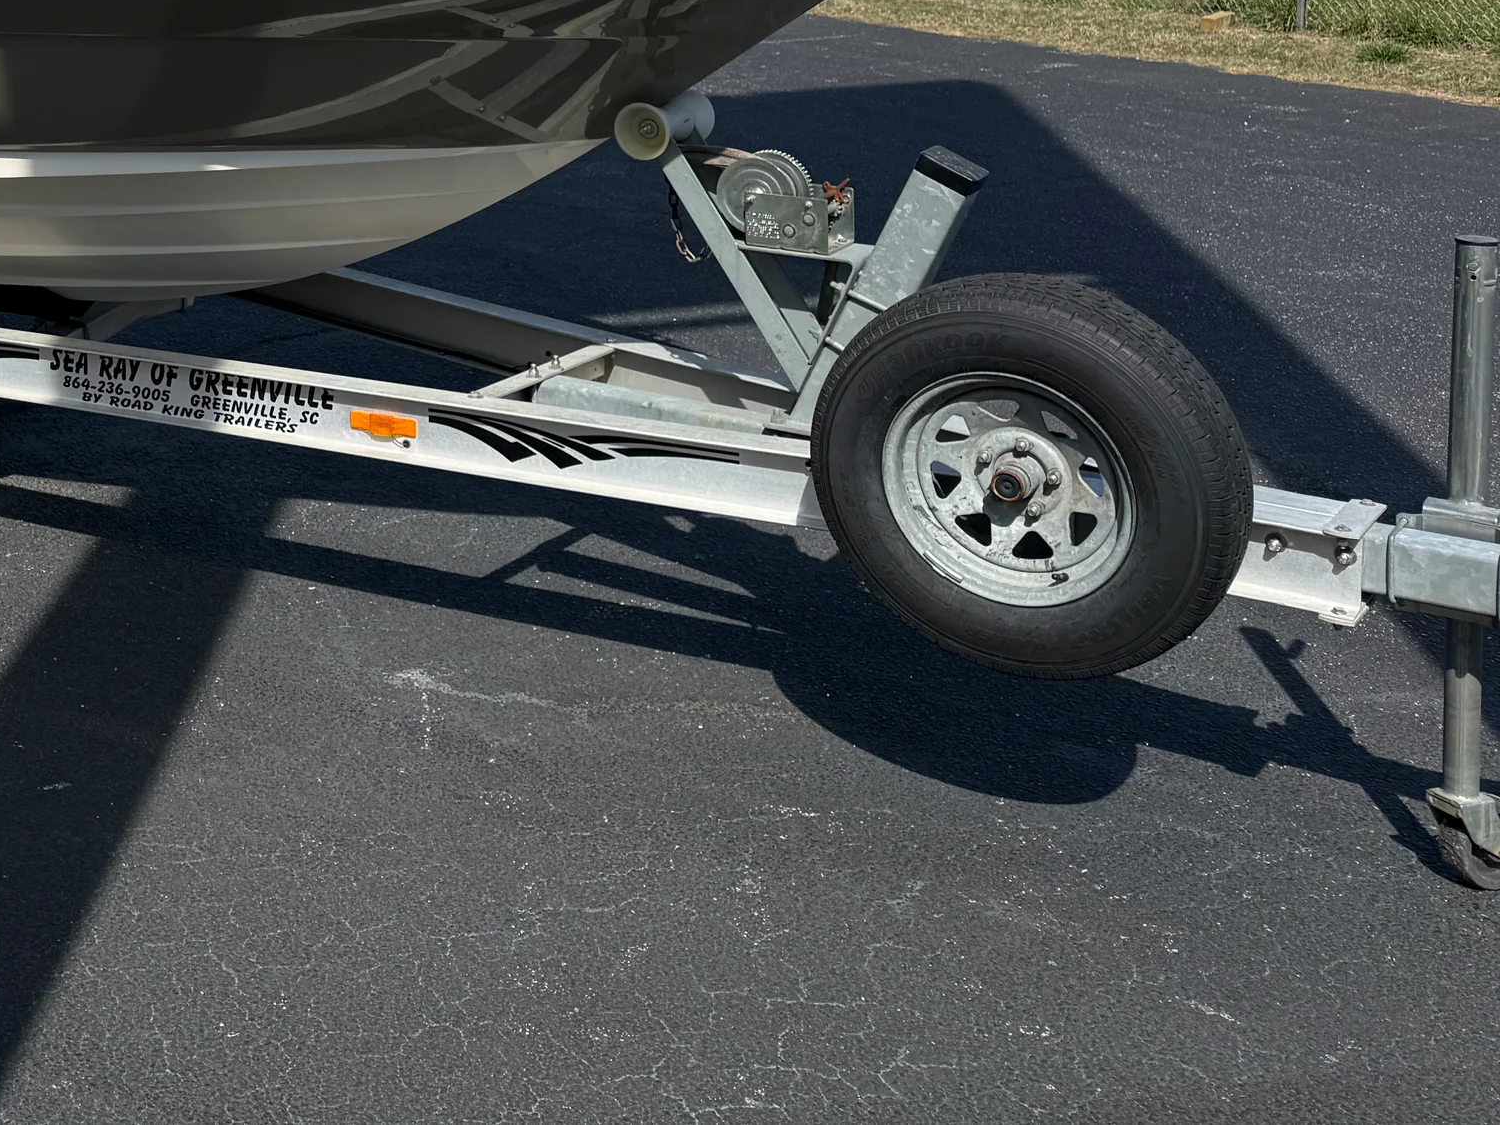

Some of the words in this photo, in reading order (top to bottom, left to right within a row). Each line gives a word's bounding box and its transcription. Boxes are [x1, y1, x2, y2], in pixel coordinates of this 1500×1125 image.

[50, 348, 88, 375] SEA
[99, 354, 141, 382] RAY
[151, 363, 179, 388] OF
[188, 368, 336, 411] GREENVILLE
[63, 375, 171, 403] 864-236-9005
[190, 394, 292, 424] GREENVILLE,
[300, 410, 320, 425] SC
[81, 392, 103, 403] BY
[109, 396, 154, 412] ROAD
[161, 404, 205, 420] KING
[213, 411, 299, 434] TRAILERS
